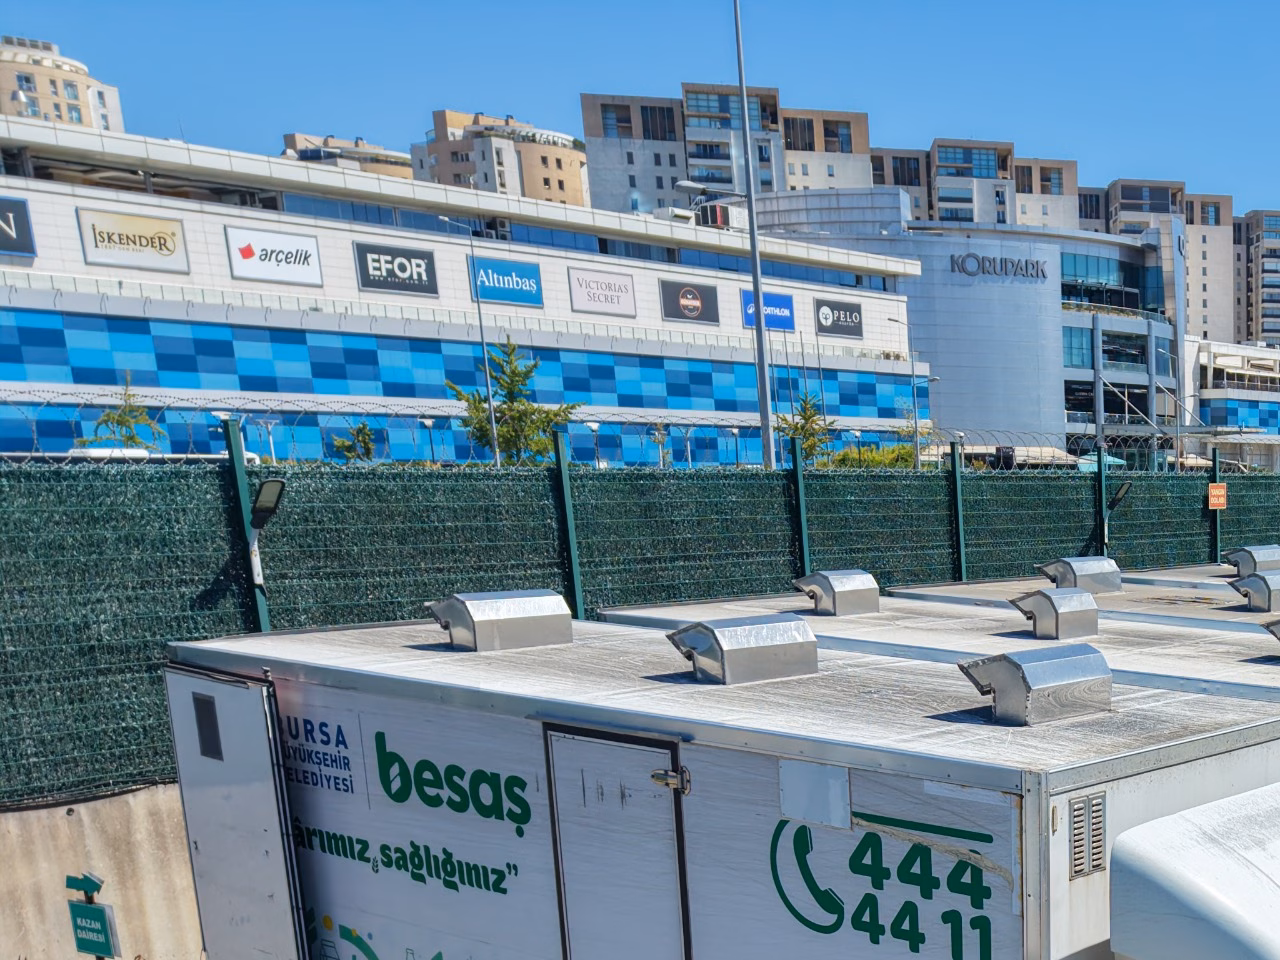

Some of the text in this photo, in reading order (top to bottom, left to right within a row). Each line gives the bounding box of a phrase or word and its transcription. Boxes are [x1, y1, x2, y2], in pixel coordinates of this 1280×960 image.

[92, 224, 173, 253] İSKENDER
[259, 248, 312, 267] arçelik
[366, 253, 428, 281] EFOR
[950, 253, 1048, 279] KORUPARK
[477, 269, 537, 294] Altınbaş
[577, 277, 629, 294] VICTORIA'S
[587, 291, 621, 305] SECRET
[762, 306, 790, 317] CATHLON
[833, 311, 860, 323] PELO
[281, 715, 349, 749] URSA
[284, 740, 351, 772] ÜYÜKŞEHİR
[286, 766, 354, 794] ELEDİYESİ
[375, 731, 532, 838] besaş
[848, 831, 992, 910] 444
[76, 917, 102, 930] KAZAN
[77, 928, 106, 944] DAİRESİ
[850, 892, 926, 954] 44
